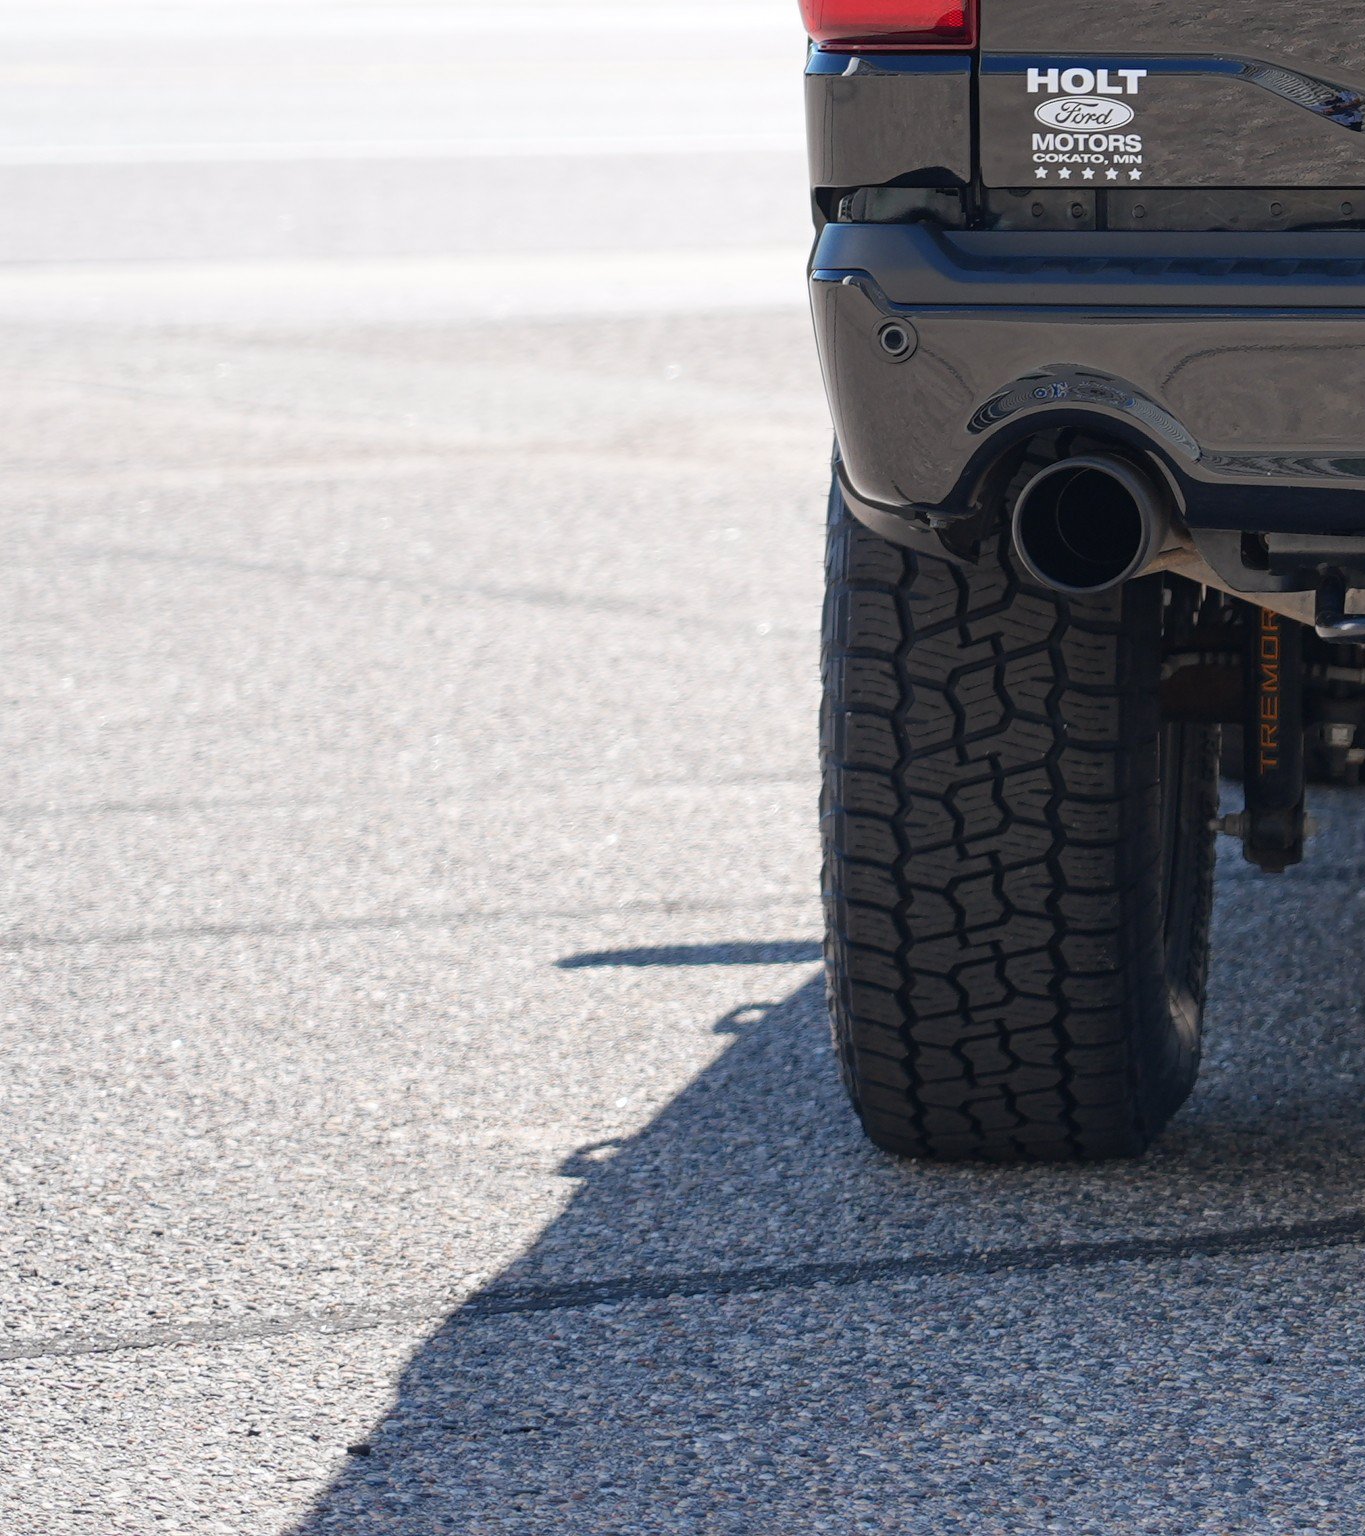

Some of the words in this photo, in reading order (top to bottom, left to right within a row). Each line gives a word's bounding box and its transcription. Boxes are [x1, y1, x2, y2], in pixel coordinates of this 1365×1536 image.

[1027, 67, 1147, 94] HOLT
[1055, 101, 1113, 125] Ford
[1032, 133, 1142, 152] MOTORS
[1032, 153, 1109, 165] COKATO,
[1113, 154, 1142, 164] MN
[1260, 607, 1281, 775] TREMOR
